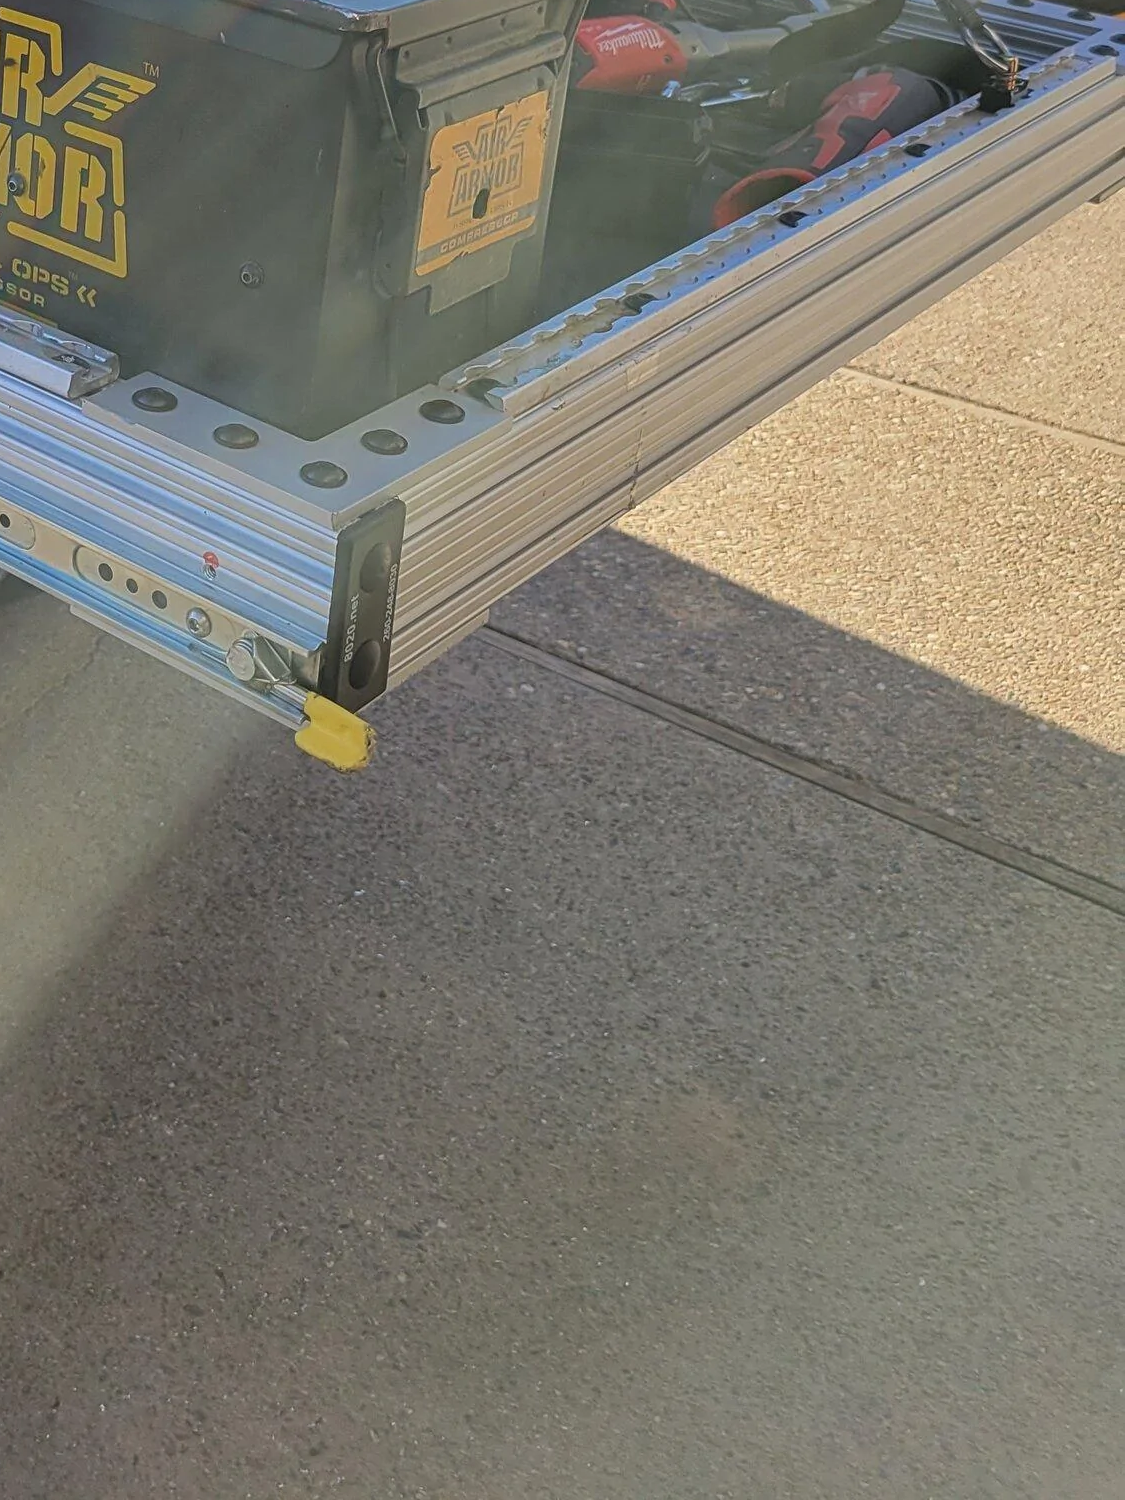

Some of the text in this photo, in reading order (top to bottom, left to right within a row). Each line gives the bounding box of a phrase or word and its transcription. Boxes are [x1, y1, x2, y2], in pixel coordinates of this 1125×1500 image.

[477, 126, 509, 165] AIR
[11, 258, 70, 296] OPS
[344, 593, 359, 662] 8020.net
